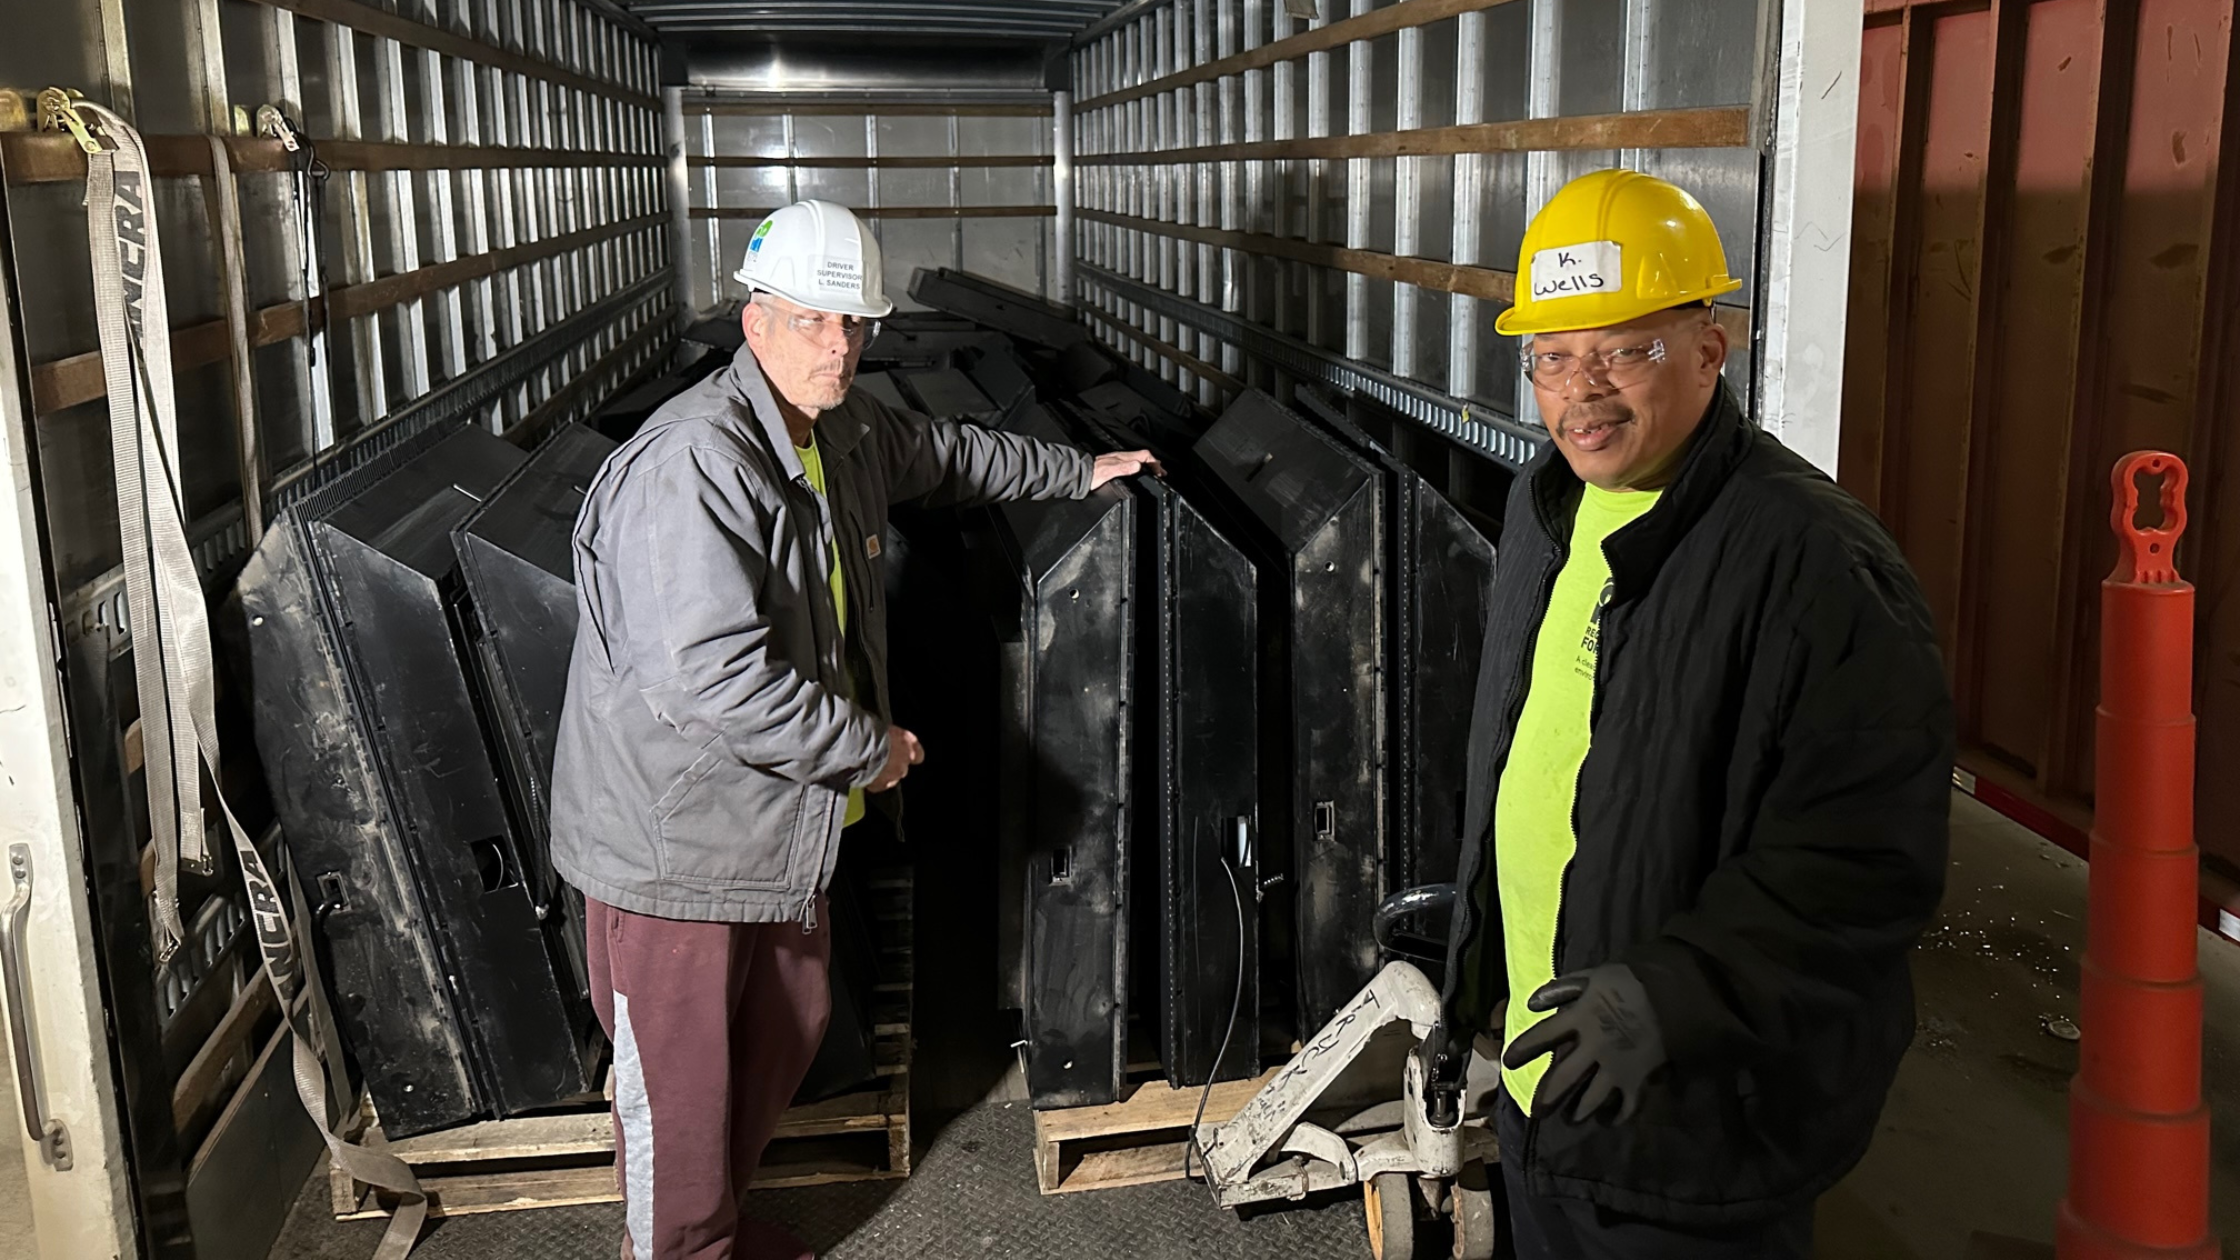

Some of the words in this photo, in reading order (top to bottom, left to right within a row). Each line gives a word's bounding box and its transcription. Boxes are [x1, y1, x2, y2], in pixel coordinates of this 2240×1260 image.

[1558, 252, 1582, 268] K.
[827, 261, 854, 271] DRIVER
[817, 270, 862, 281] SUPERVISOR
[826, 279, 860, 290] SANDERS
[1277, 989, 1380, 1092] TRUCK
